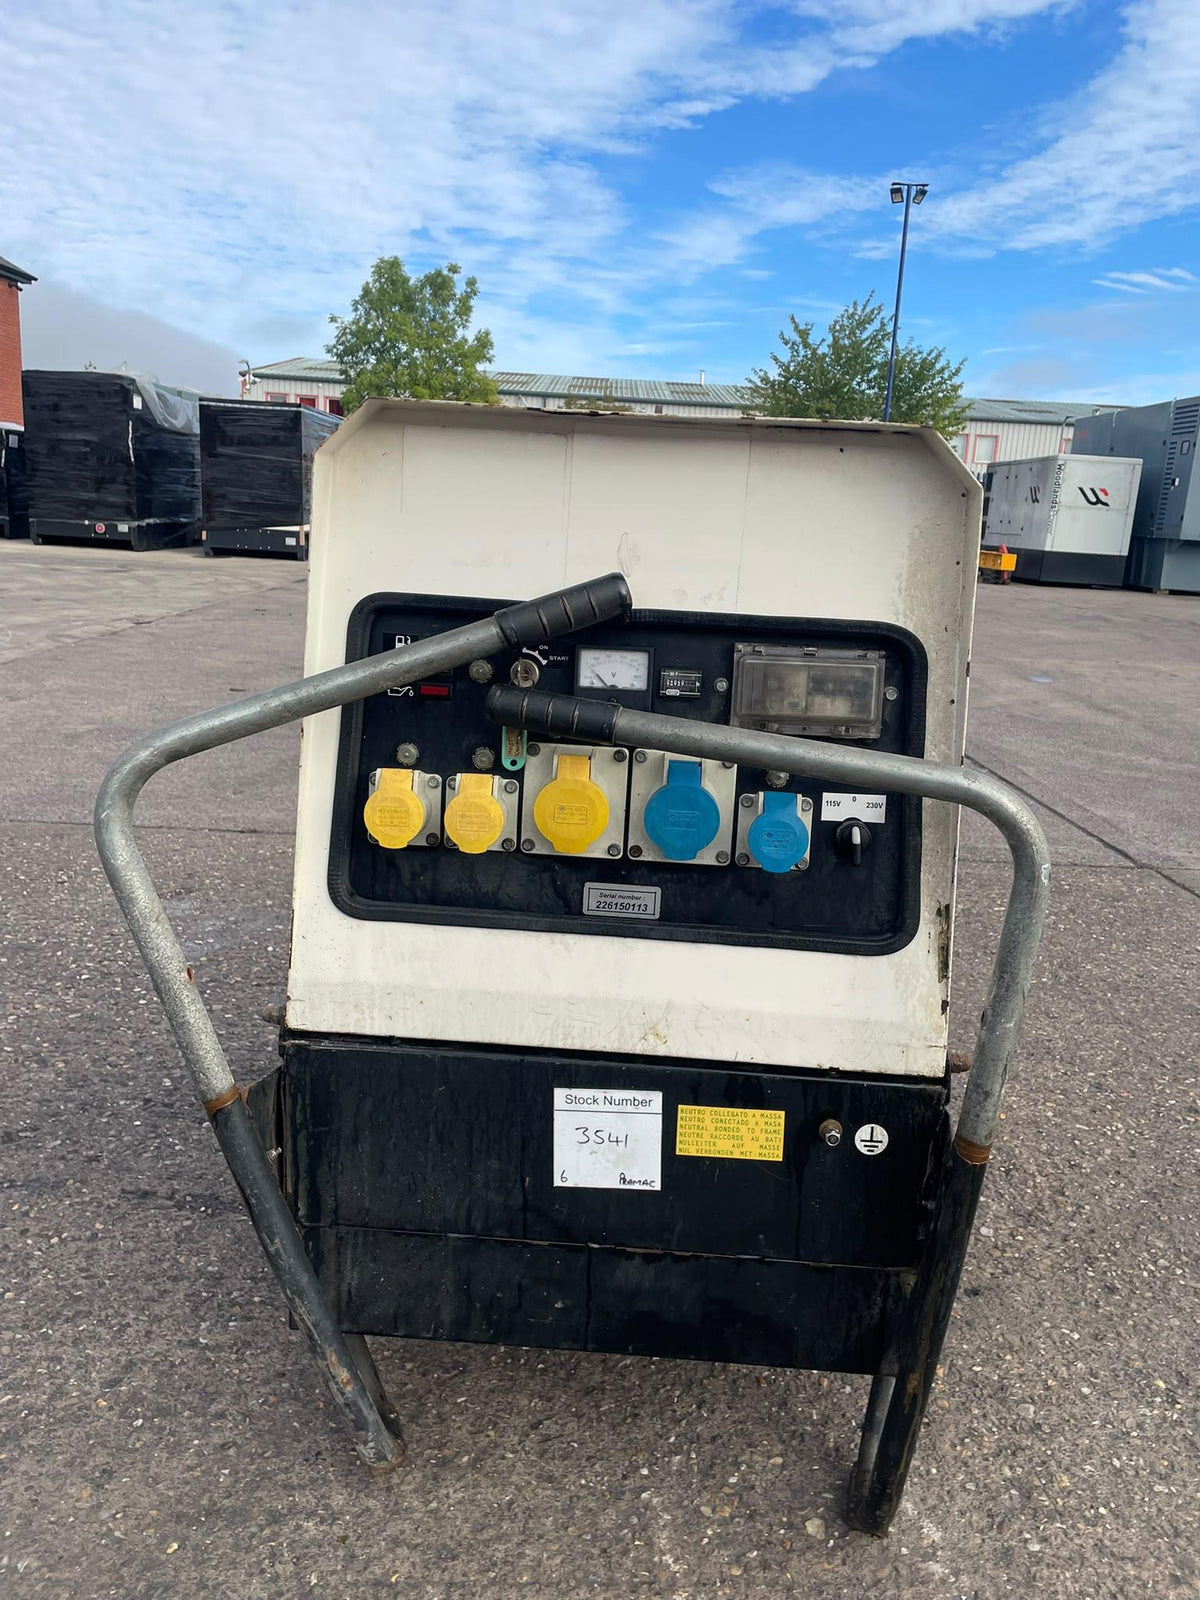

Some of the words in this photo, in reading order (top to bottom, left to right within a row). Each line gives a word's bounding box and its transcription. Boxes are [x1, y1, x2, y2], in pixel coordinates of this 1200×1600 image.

[866, 801, 883, 809] 230V
[596, 901, 648, 912] 226150113
[565, 1094, 599, 1106] Stock
[603, 1096, 653, 1107] Number
[710, 1110, 748, 1118] COLLEGATO
[711, 1118, 749, 1126] CONECTADO
[575, 1126, 628, 1148] 3541
[696, 1148, 734, 1156] VERBONDEN
[758, 1151, 780, 1159] MASSA
[560, 1169, 568, 1183] 6
